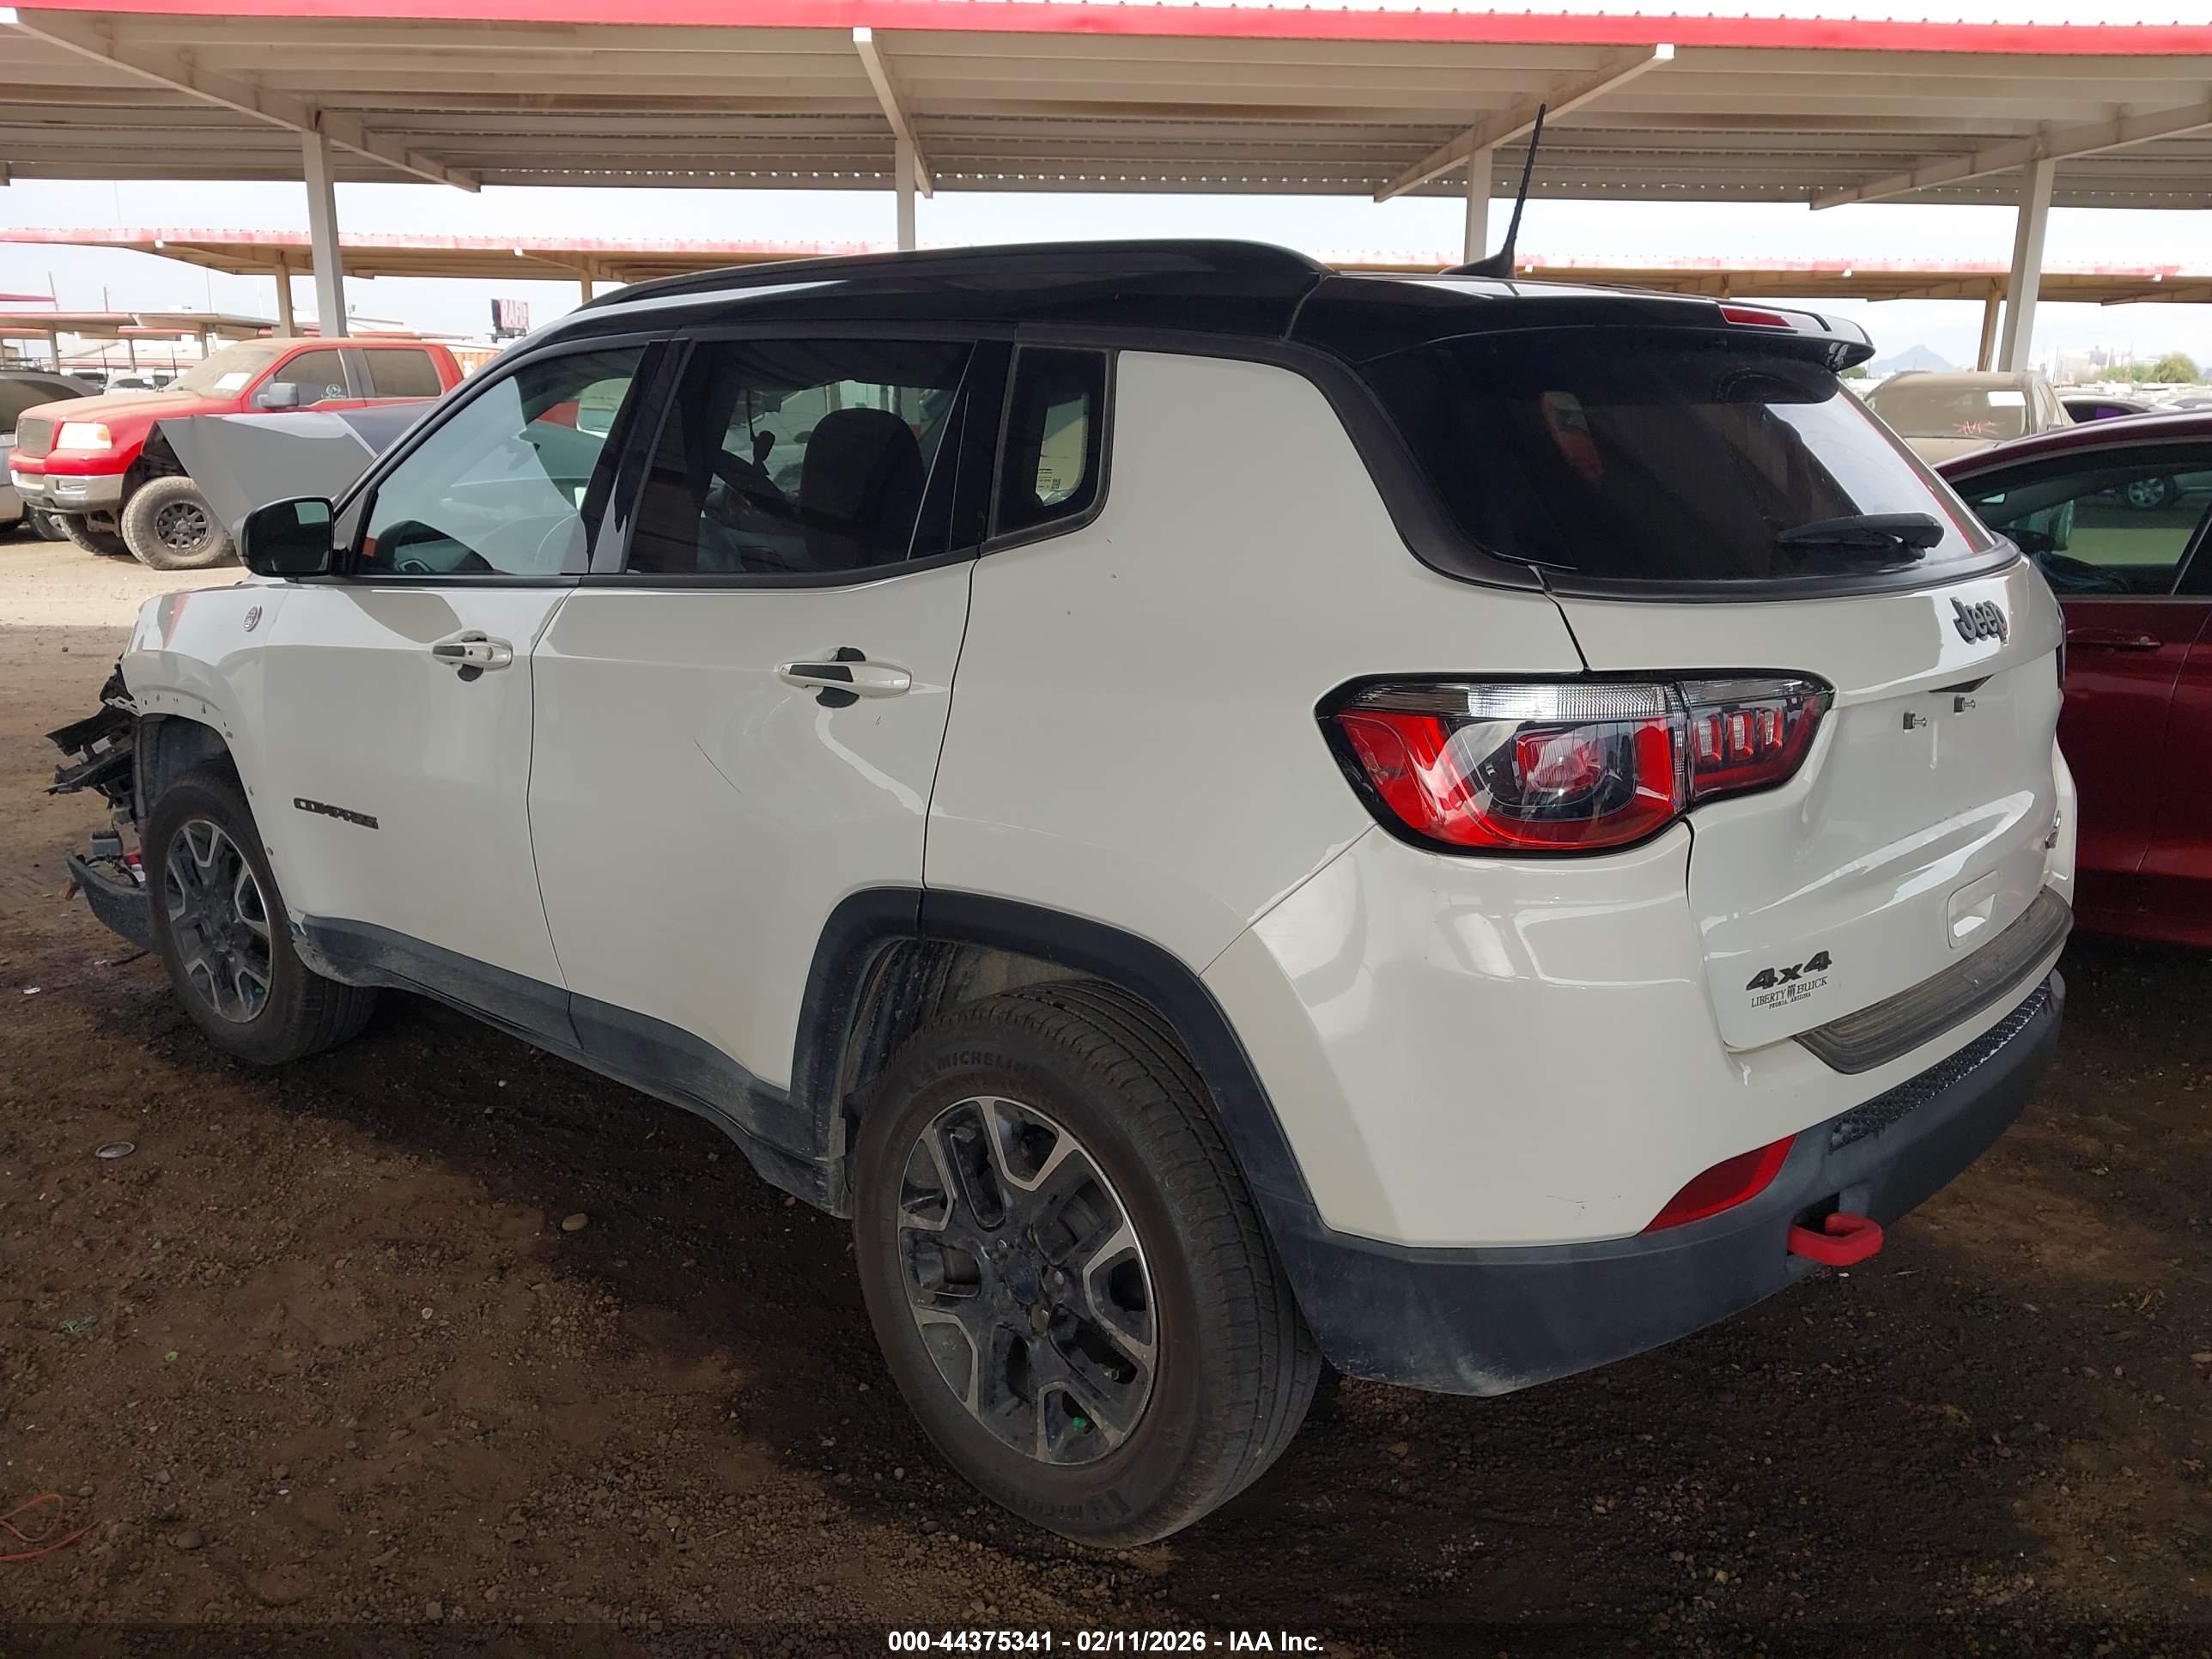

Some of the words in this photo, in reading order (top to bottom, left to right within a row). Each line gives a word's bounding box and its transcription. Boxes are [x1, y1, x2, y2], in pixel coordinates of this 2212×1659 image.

[1949, 597, 2008, 645] Jeep
[294, 797, 379, 830] COMPASS
[1746, 950, 1832, 991] 4x4
[1751, 989, 1787, 1008] LIBERTY
[1796, 975, 1828, 994] BUICK
